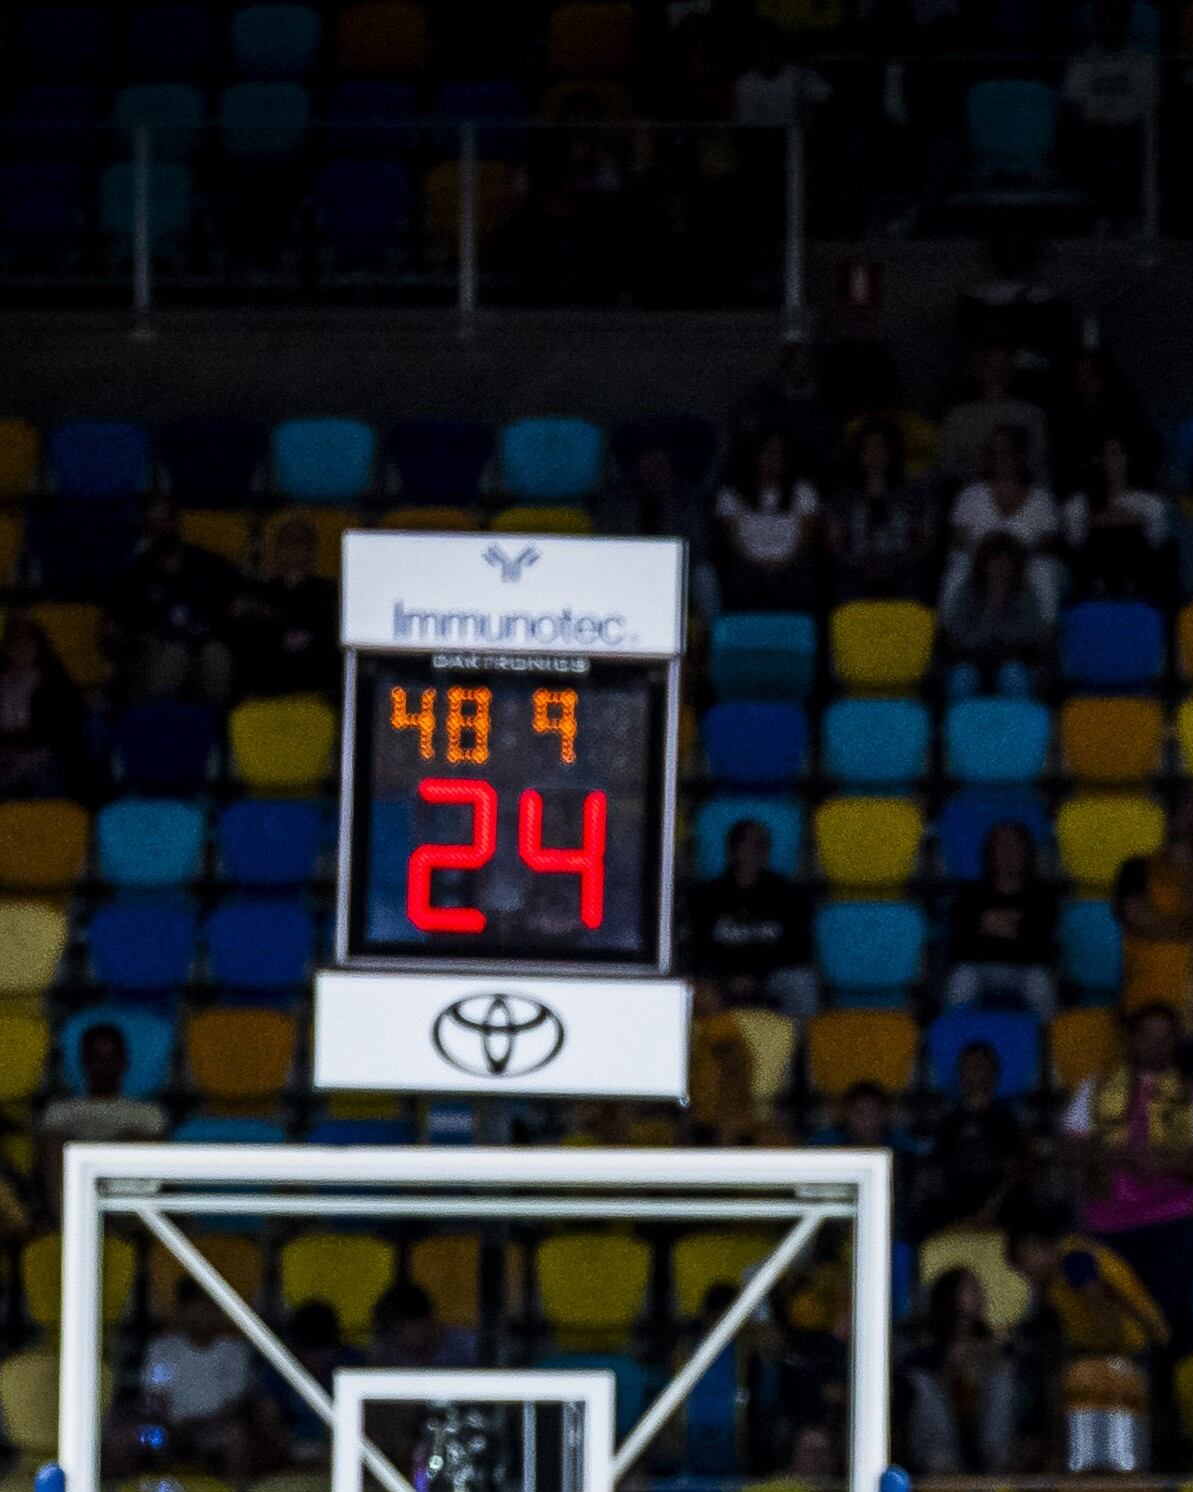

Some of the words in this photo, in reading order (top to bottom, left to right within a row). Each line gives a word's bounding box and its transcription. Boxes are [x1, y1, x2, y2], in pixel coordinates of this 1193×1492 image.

[391, 686, 492, 764] 48
[533, 687, 578, 764] 9
[407, 778, 607, 932] 24
